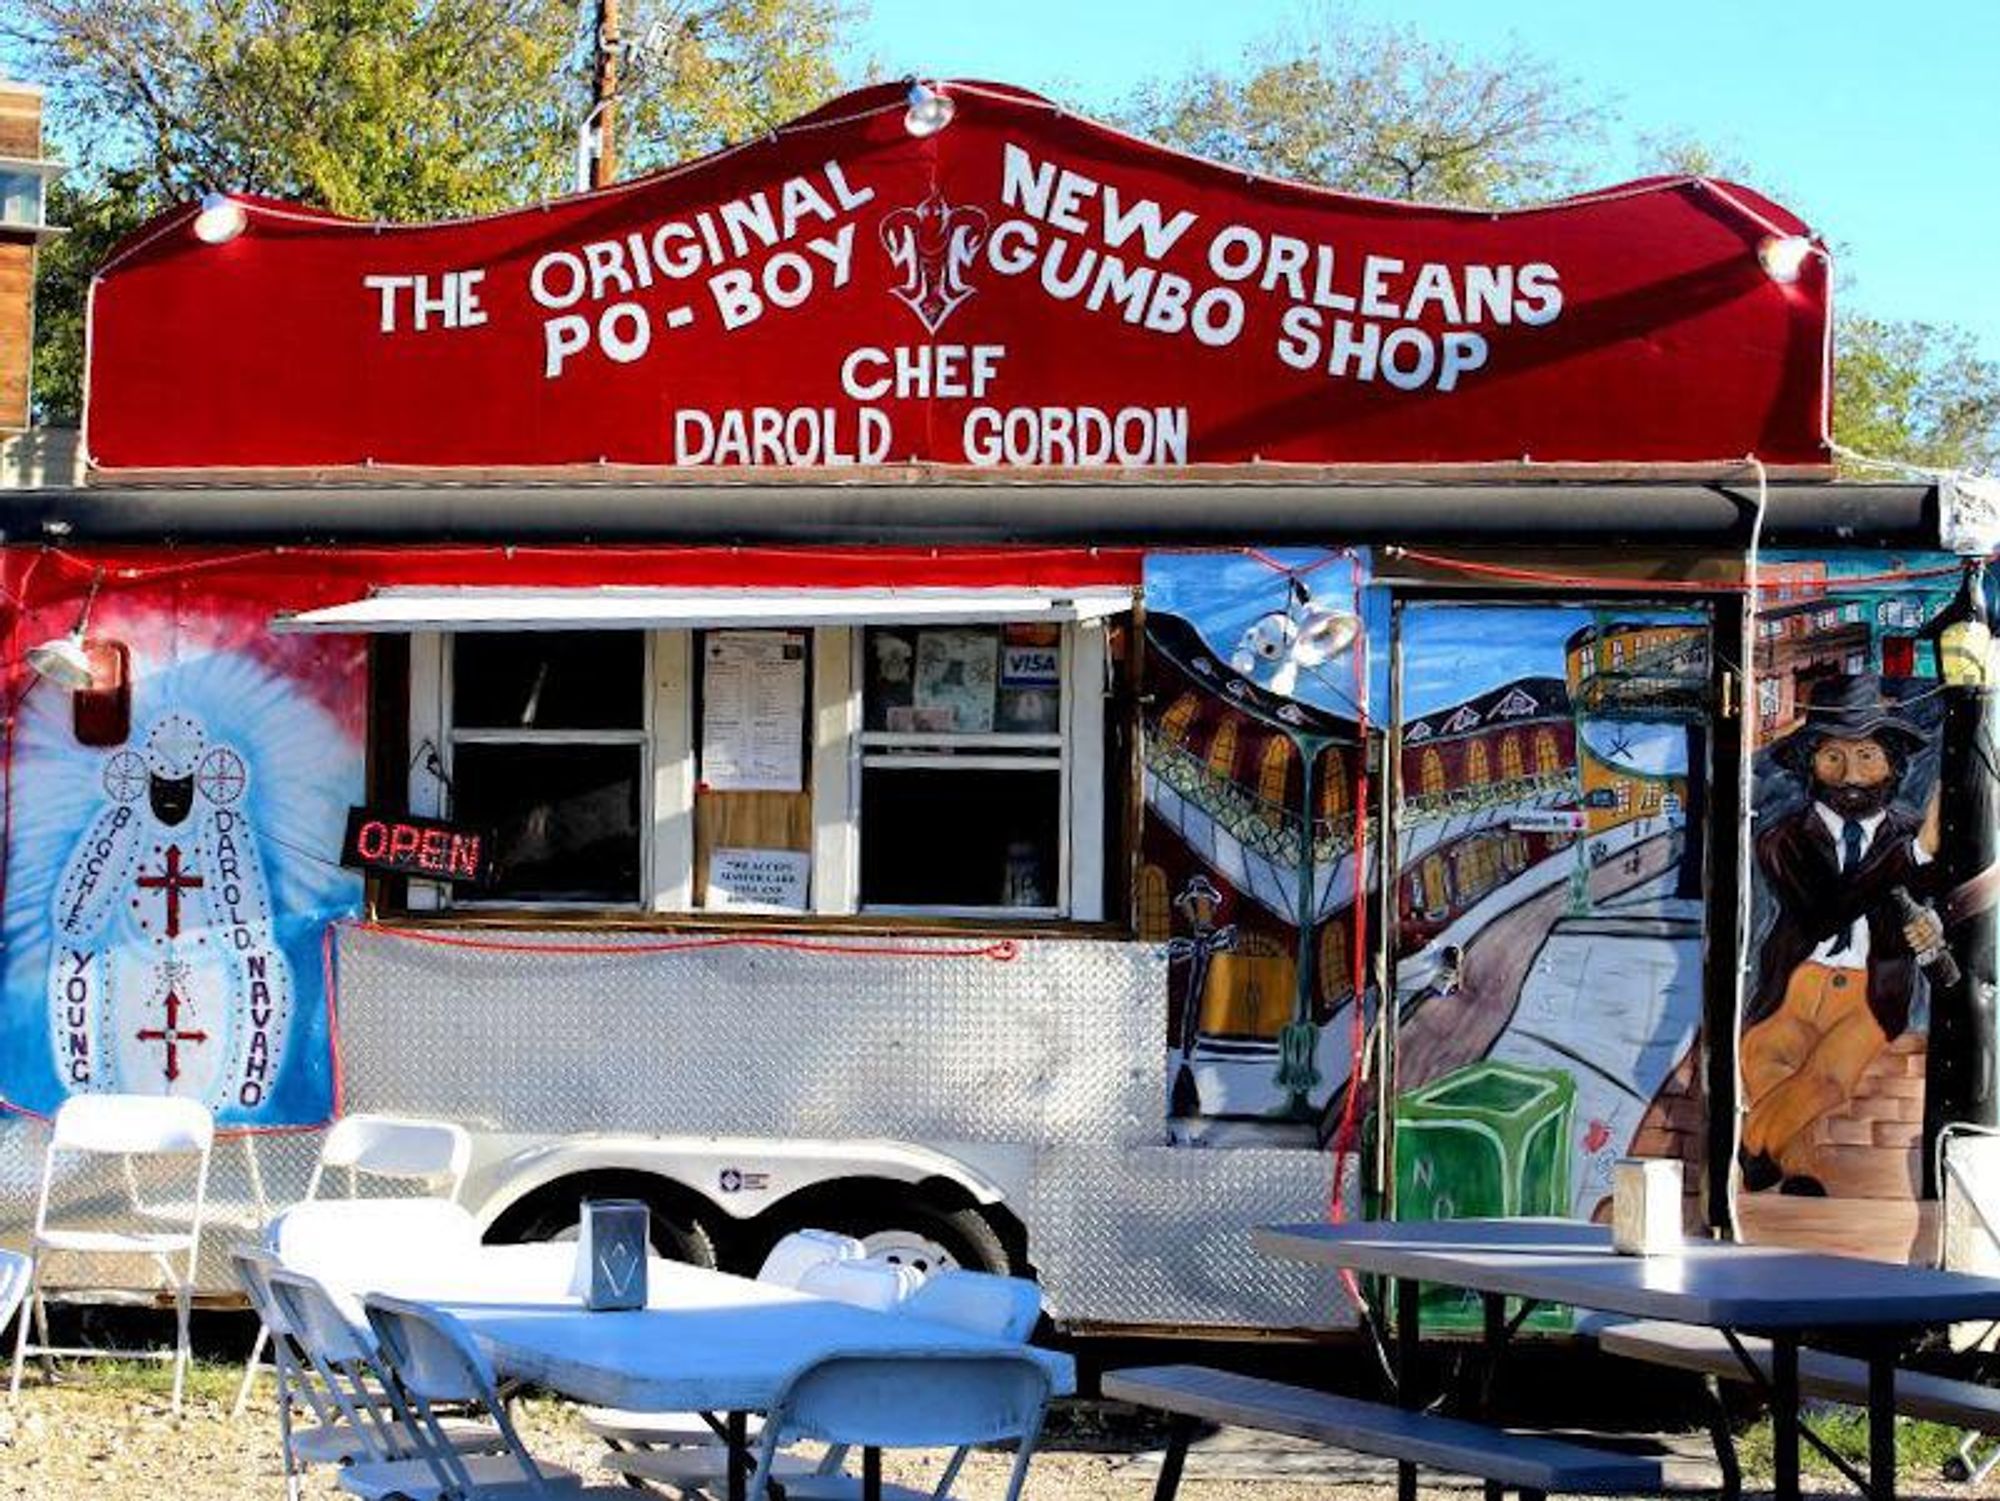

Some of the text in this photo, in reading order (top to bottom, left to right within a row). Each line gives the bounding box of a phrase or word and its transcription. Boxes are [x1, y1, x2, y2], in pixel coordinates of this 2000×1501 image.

[364, 143, 1564, 333] THE ORIGINAL NEW ORLEANS
[841, 345, 1006, 401] CHEF
[987, 221, 1246, 348] GUMBO
[1277, 306, 1489, 393] SHOP
[674, 407, 1189, 467] DAROLD GORDON
[1010, 654, 1057, 673] VISA
[215, 810, 252, 950] DAROLD
[357, 821, 480, 880] OPEN
[66, 951, 95, 1083] YOUNG
[240, 956, 273, 1107] NAVAHO
